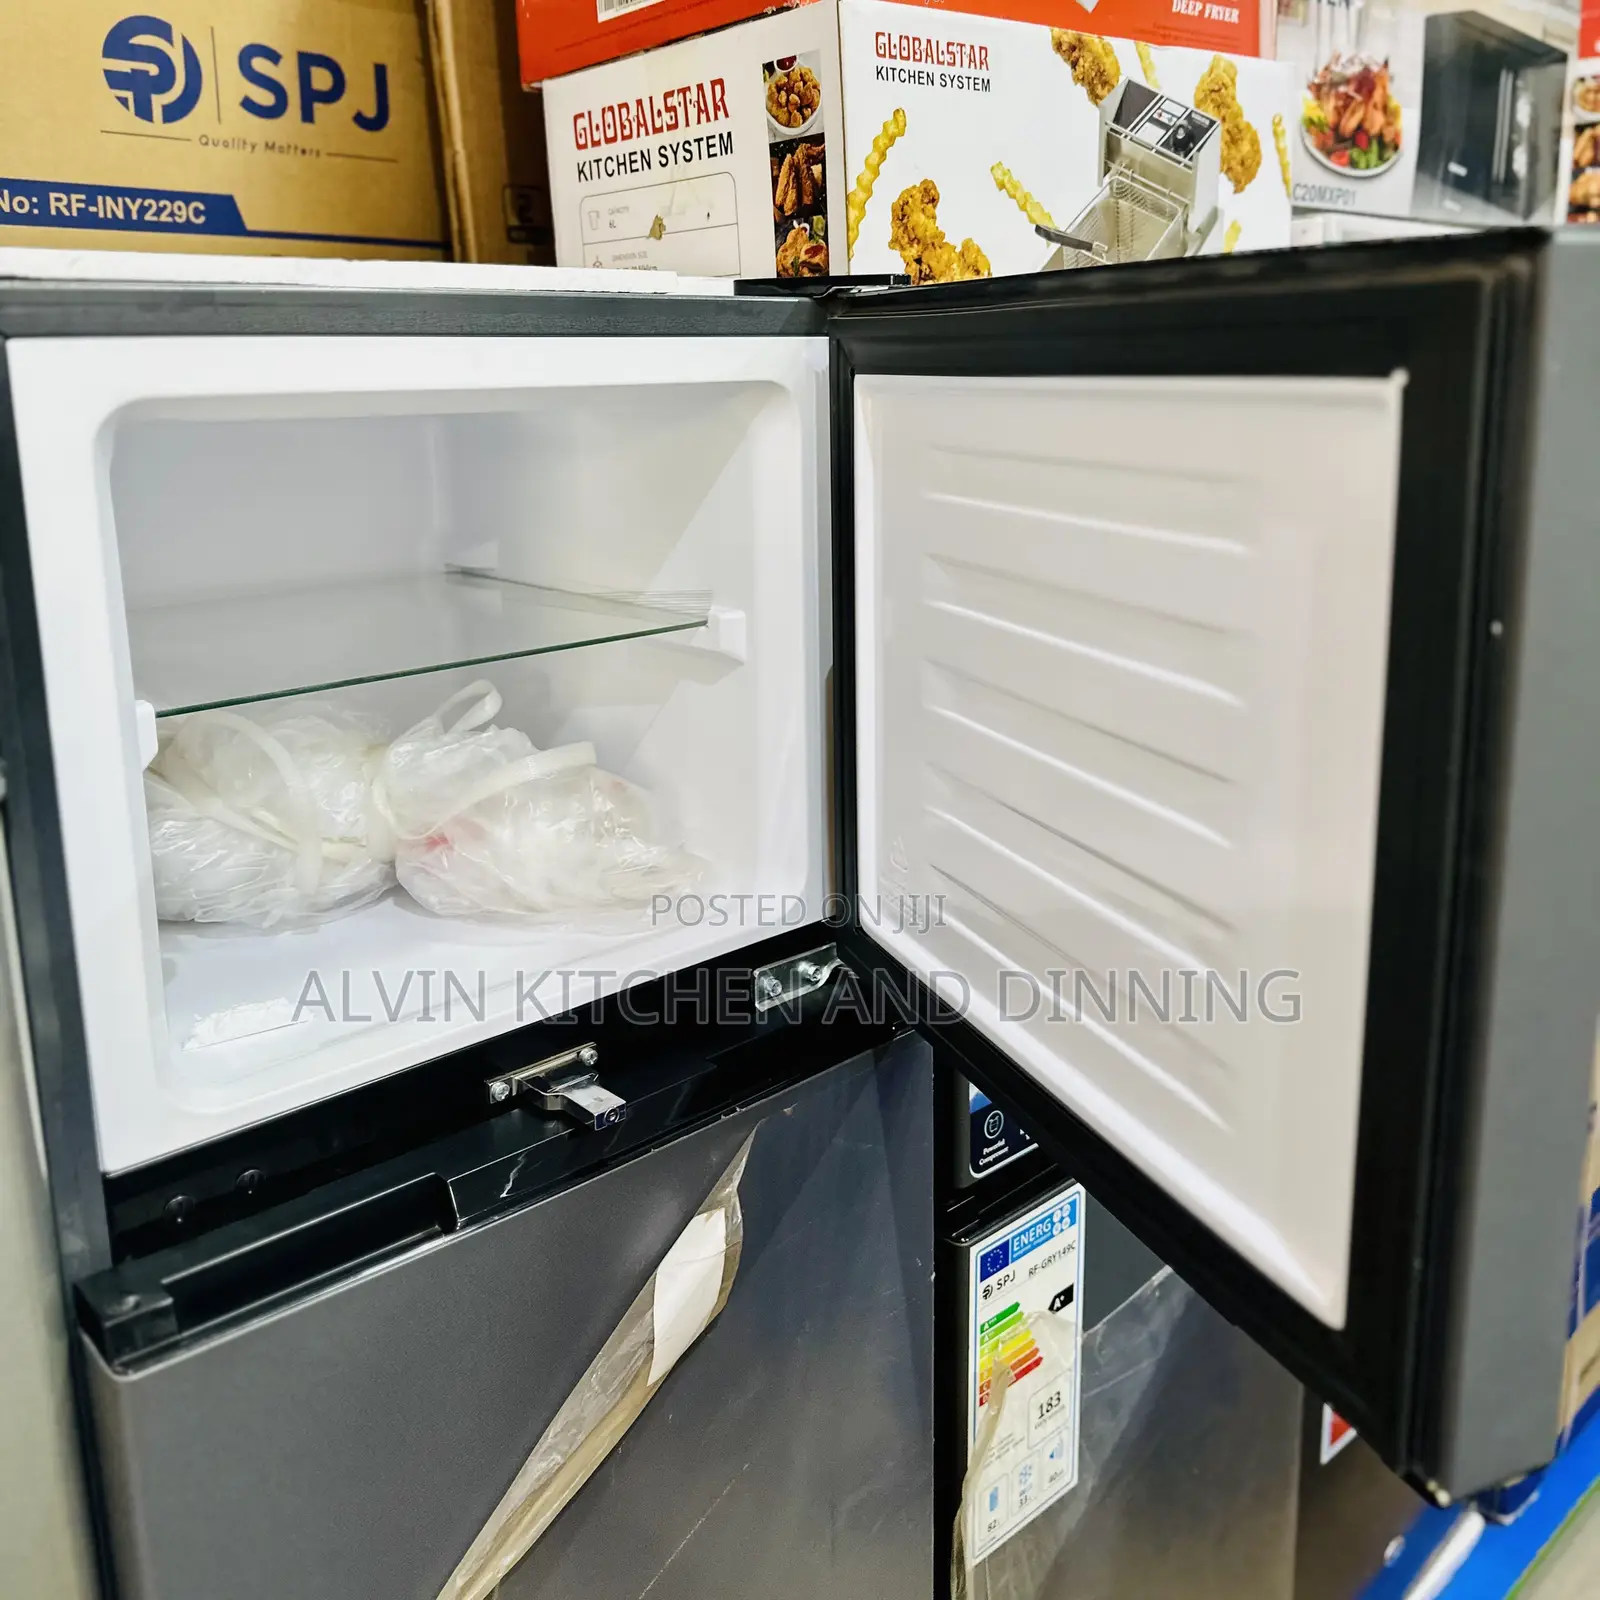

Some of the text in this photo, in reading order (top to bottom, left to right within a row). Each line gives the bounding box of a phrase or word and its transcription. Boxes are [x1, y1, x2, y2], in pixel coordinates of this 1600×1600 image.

[1172, 0, 1240, 24] DEEP FRYER
[875, 31, 989, 71] GLOBALSTAR
[238, 43, 391, 132] SPJ
[876, 65, 990, 92] KITCHEN SYSTEM
[573, 78, 729, 150] GLOBALSTAR
[198, 134, 321, 158] Quality Matters
[577, 131, 734, 183] KITCHEN SYSTEM
[49, 192, 206, 224] RF-INY229C
[1013, 1218, 1051, 1251] ENERG
[997, 1269, 1015, 1290] SPJ
[1038, 1391, 1061, 1420] 183
